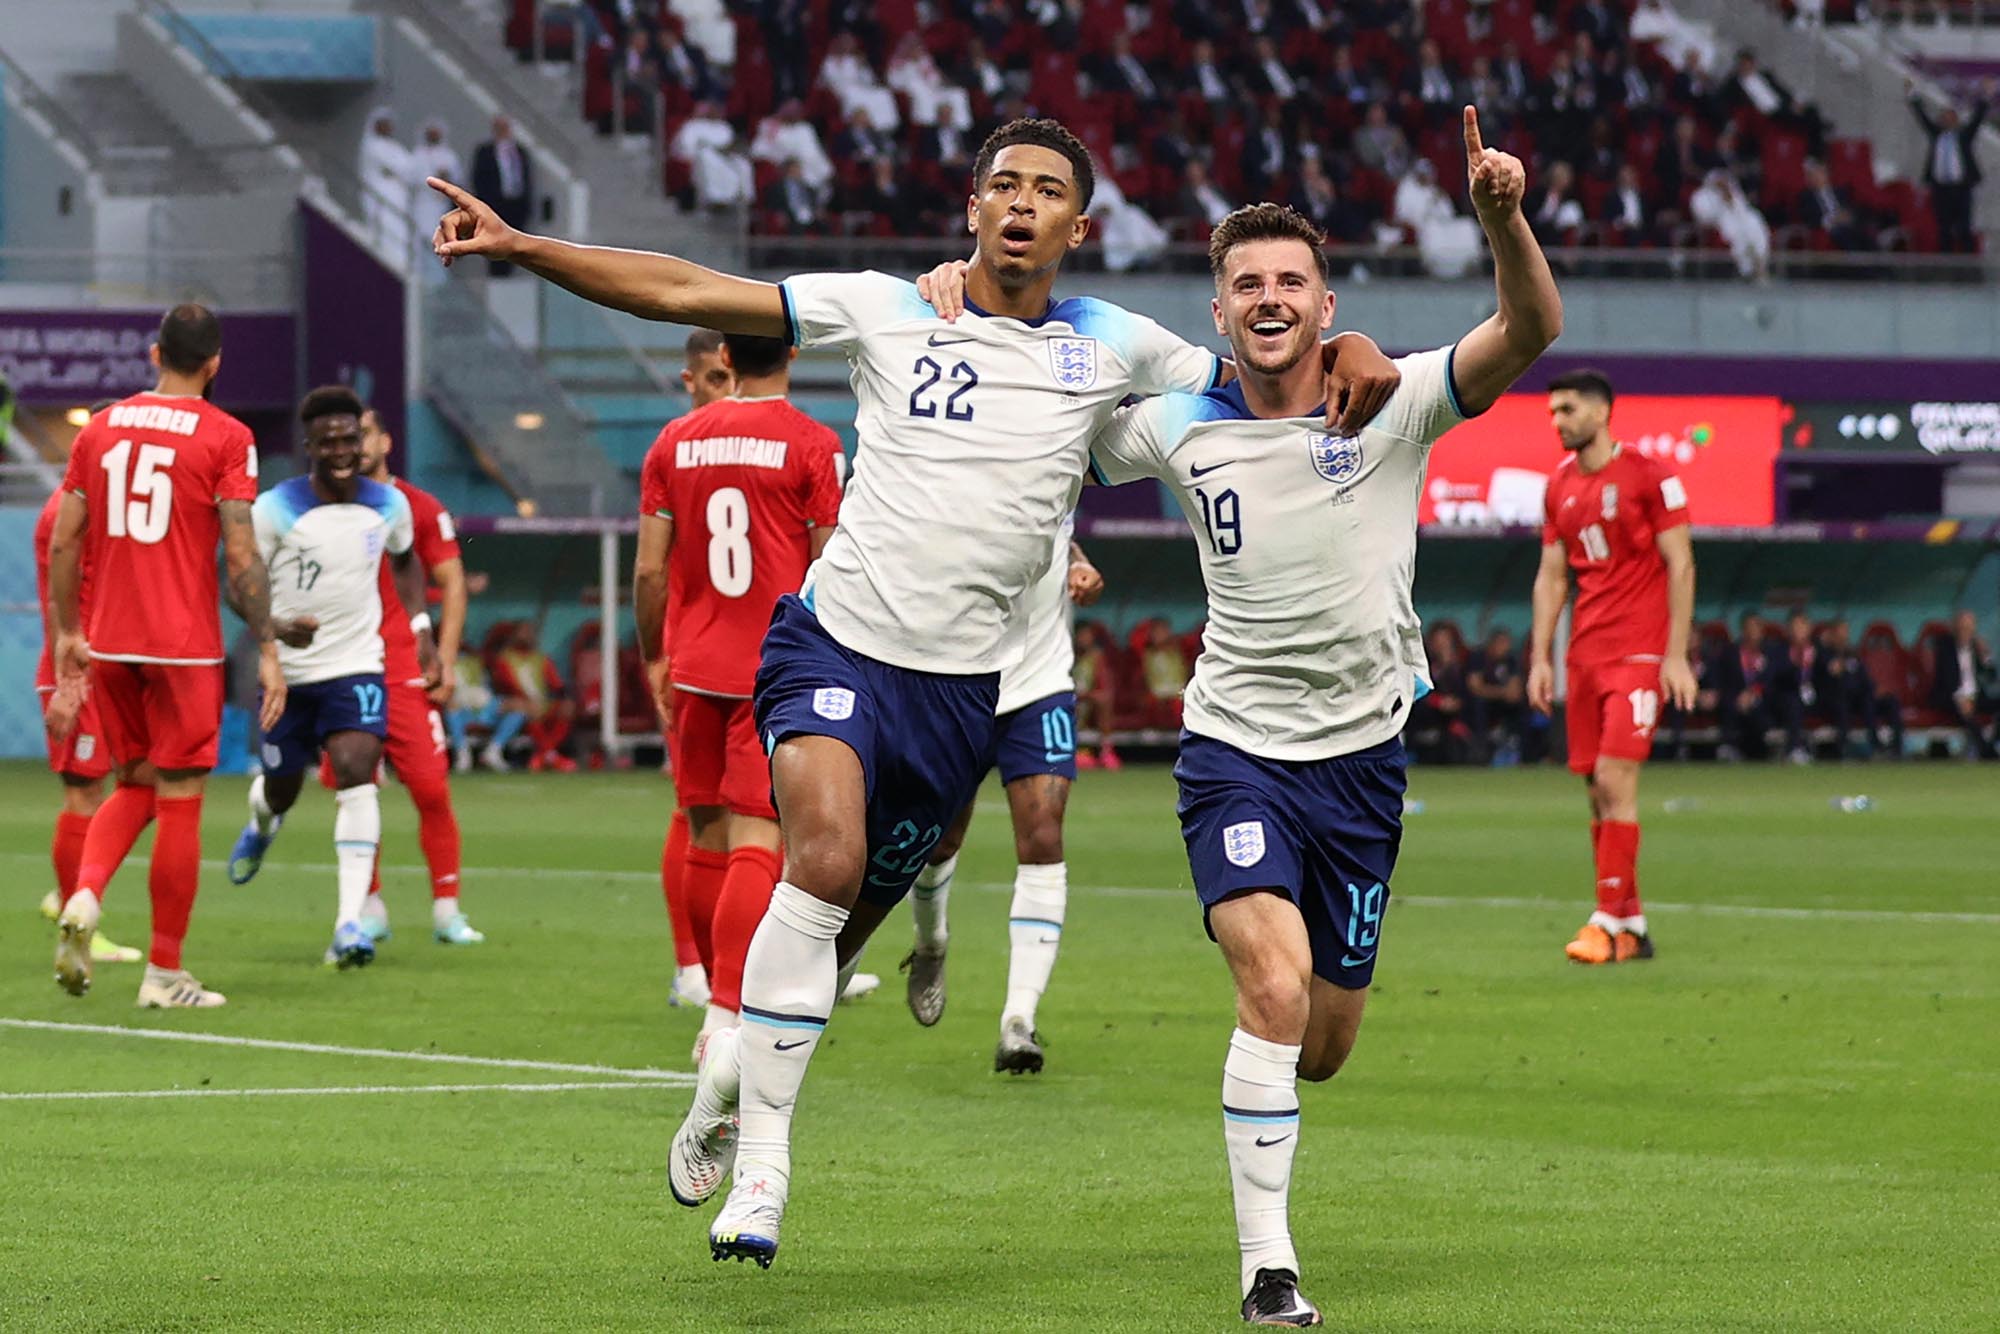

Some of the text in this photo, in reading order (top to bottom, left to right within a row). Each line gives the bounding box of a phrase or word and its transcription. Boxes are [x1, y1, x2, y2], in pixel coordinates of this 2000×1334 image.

[909, 355, 978, 421] 22
[101, 439, 176, 544] 15
[1195, 488, 1242, 555] 19
[706, 486, 753, 598] 8
[1041, 706, 1073, 750] 10
[871, 818, 943, 875] 22
[1347, 881, 1384, 947] 19
